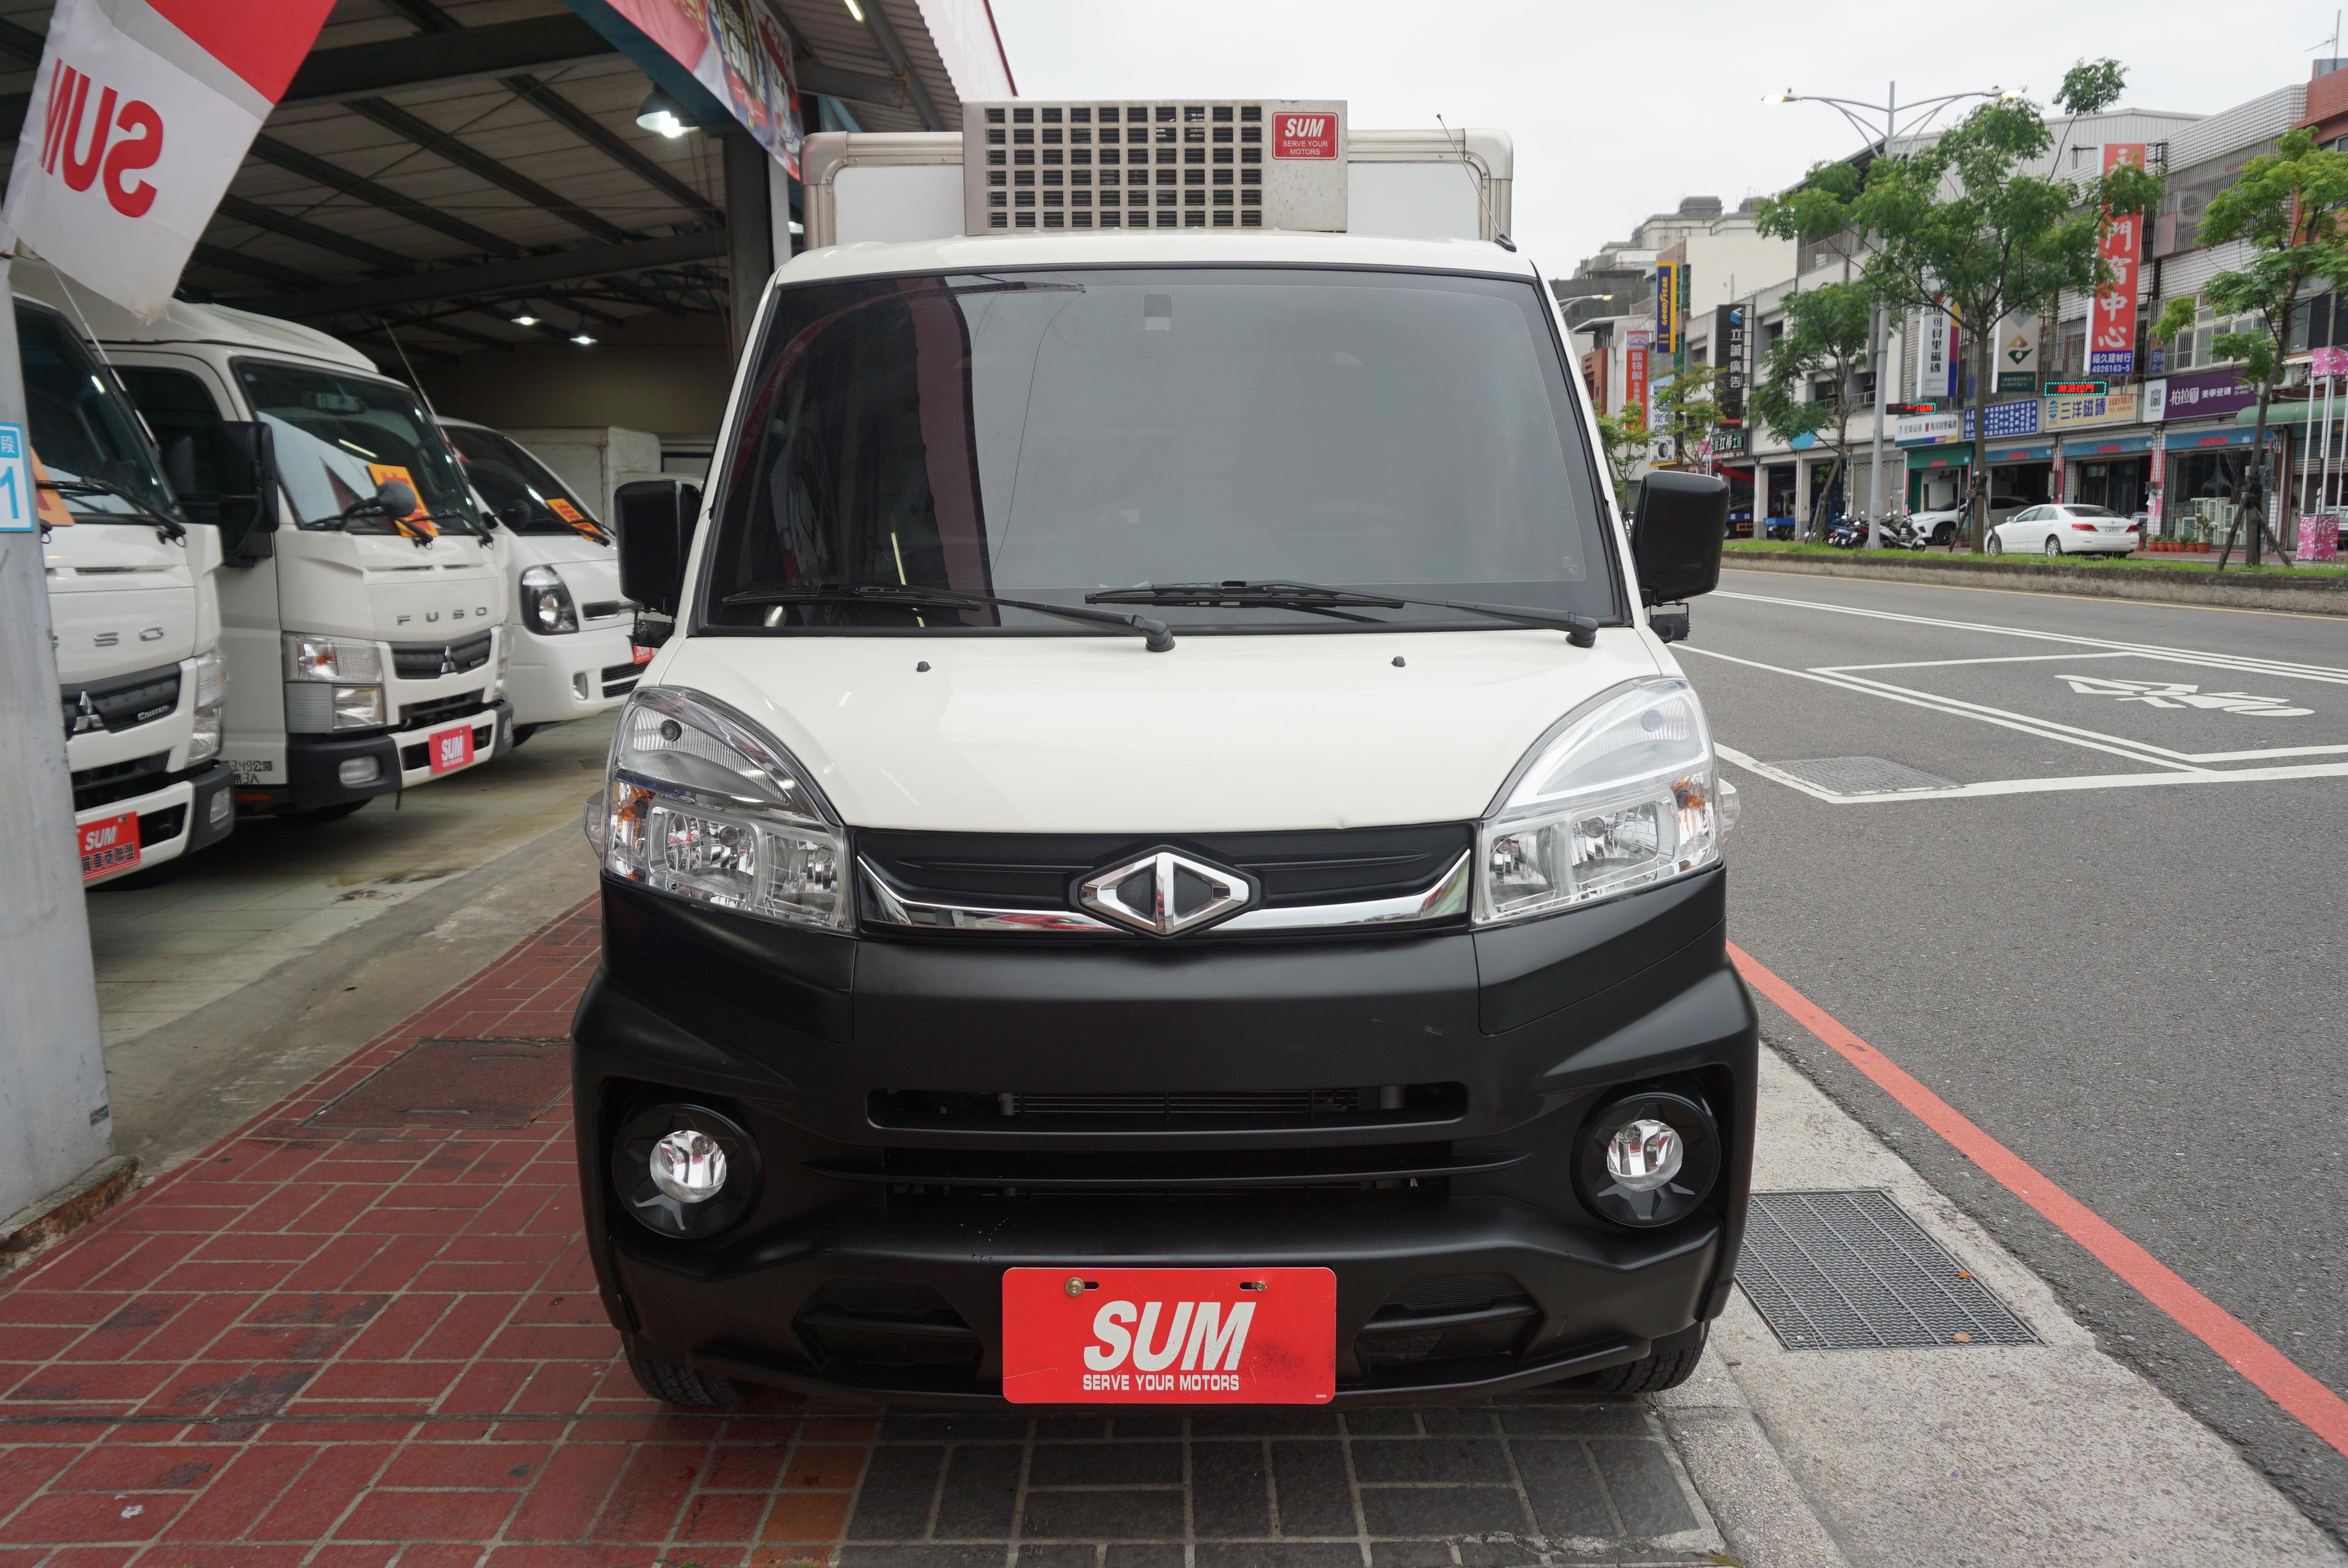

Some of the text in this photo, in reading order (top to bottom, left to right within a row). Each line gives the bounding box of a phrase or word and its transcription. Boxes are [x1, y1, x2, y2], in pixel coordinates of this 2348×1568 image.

[1285, 118, 1325, 138] SUM
[1730, 328, 1743, 388] 立誠廣告
[2092, 352, 2132, 363] 福久建材行
[2170, 386, 2231, 406] 柏拉圖 美學瓷磚
[2061, 397, 2106, 420] 三洋磁磚
[0, 435, 14, 453] 段
[397, 606, 487, 626] FUSO
[441, 735, 464, 761] SUM
[85, 826, 118, 852] SUM
[1083, 1300, 1257, 1371] SUM
[1083, 1375, 1239, 1391] SERVE YOUR MOTORS
